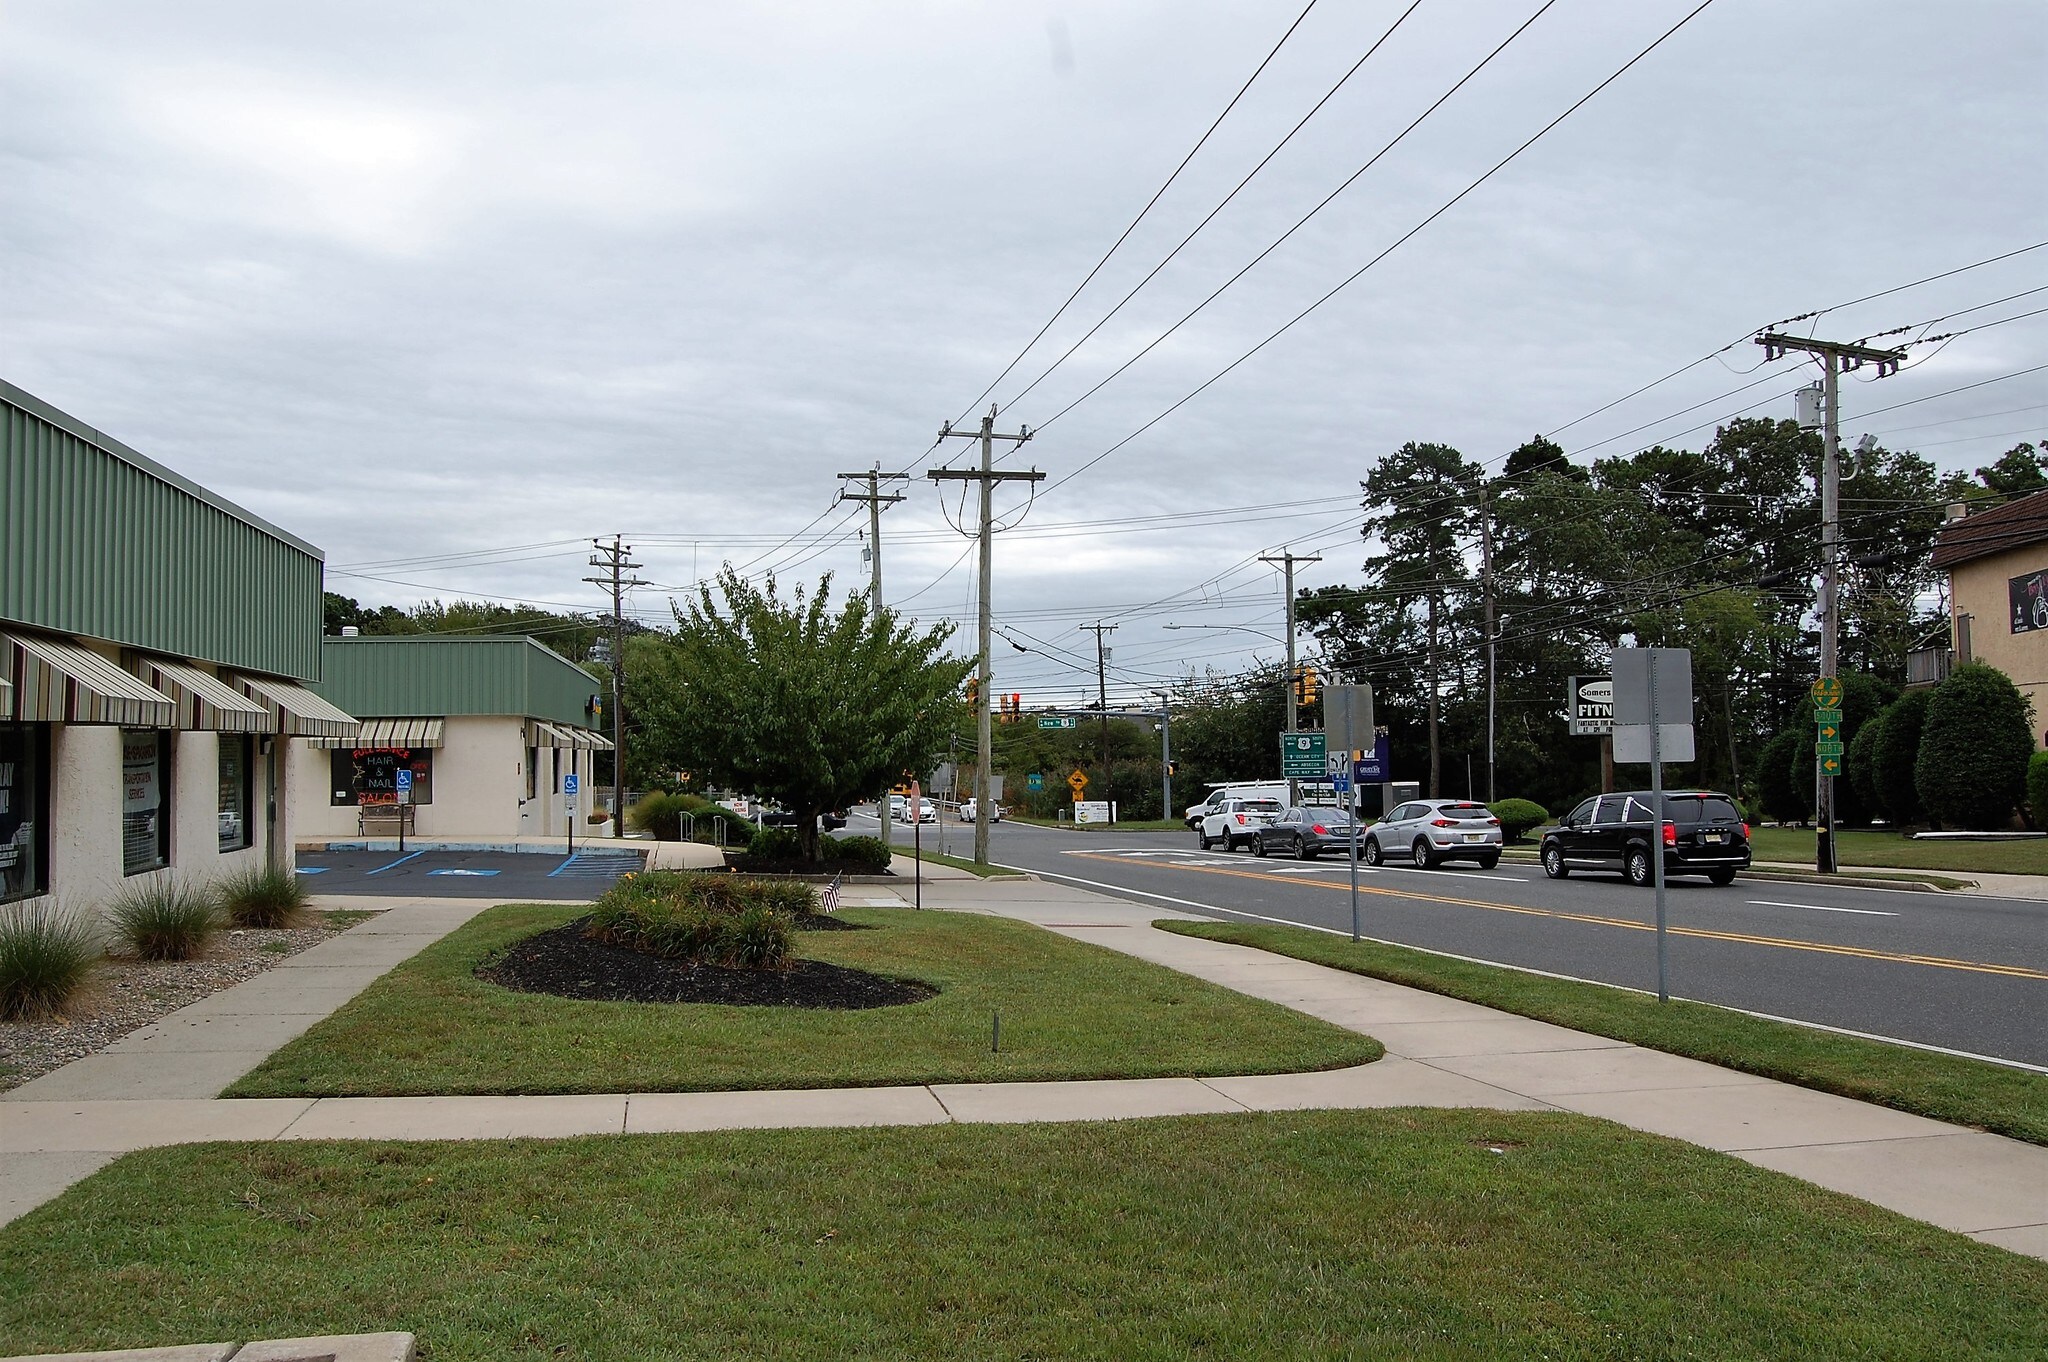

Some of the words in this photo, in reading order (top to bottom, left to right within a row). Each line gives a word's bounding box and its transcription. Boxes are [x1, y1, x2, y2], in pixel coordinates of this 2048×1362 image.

[1581, 688, 1611, 696] Somers
[1578, 704, 1612, 716] FITN
[1301, 739, 1306, 748] 9
[367, 756, 394, 766] HAIR
[376, 768, 384, 777] &
[368, 779, 394, 788] NAIL
